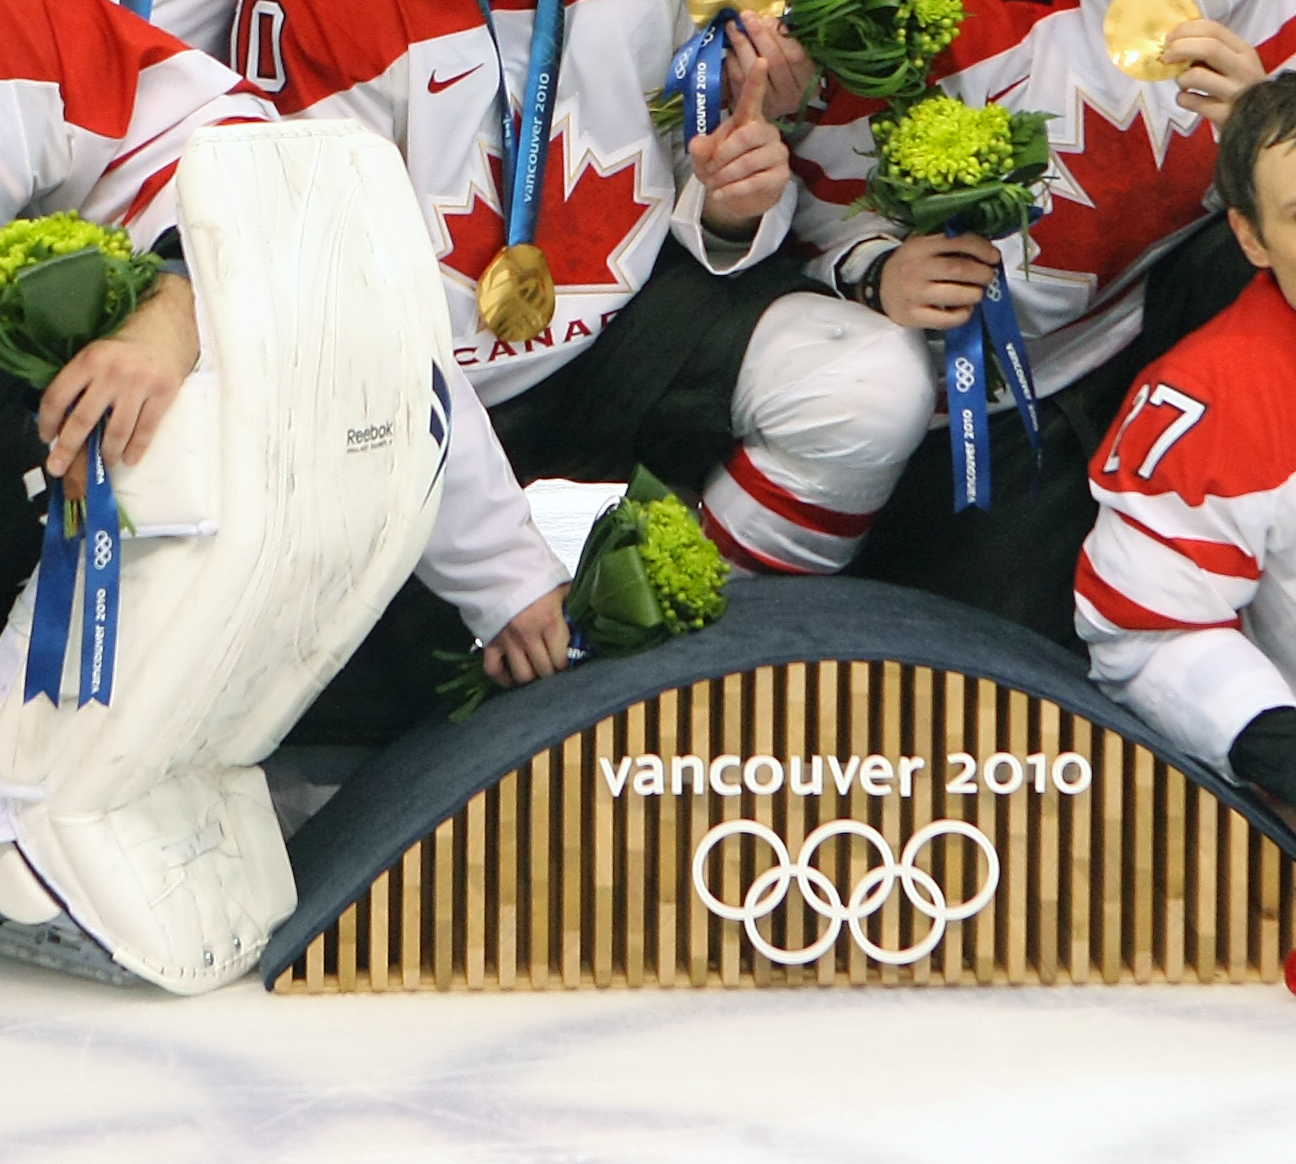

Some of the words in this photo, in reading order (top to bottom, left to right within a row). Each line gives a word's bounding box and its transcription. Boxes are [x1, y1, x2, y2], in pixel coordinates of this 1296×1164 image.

[696, 61, 708, 92] 2010
[523, 117, 543, 203] vancouver
[534, 72, 550, 112] 2010
[346, 420, 394, 446] Reebok
[962, 408, 975, 440] 2010
[964, 439, 977, 505] vancouver
[95, 588, 106, 623] 2010
[91, 624, 107, 695] vancouver
[599, 753, 925, 796] vancouver
[945, 751, 1093, 795] 2010
